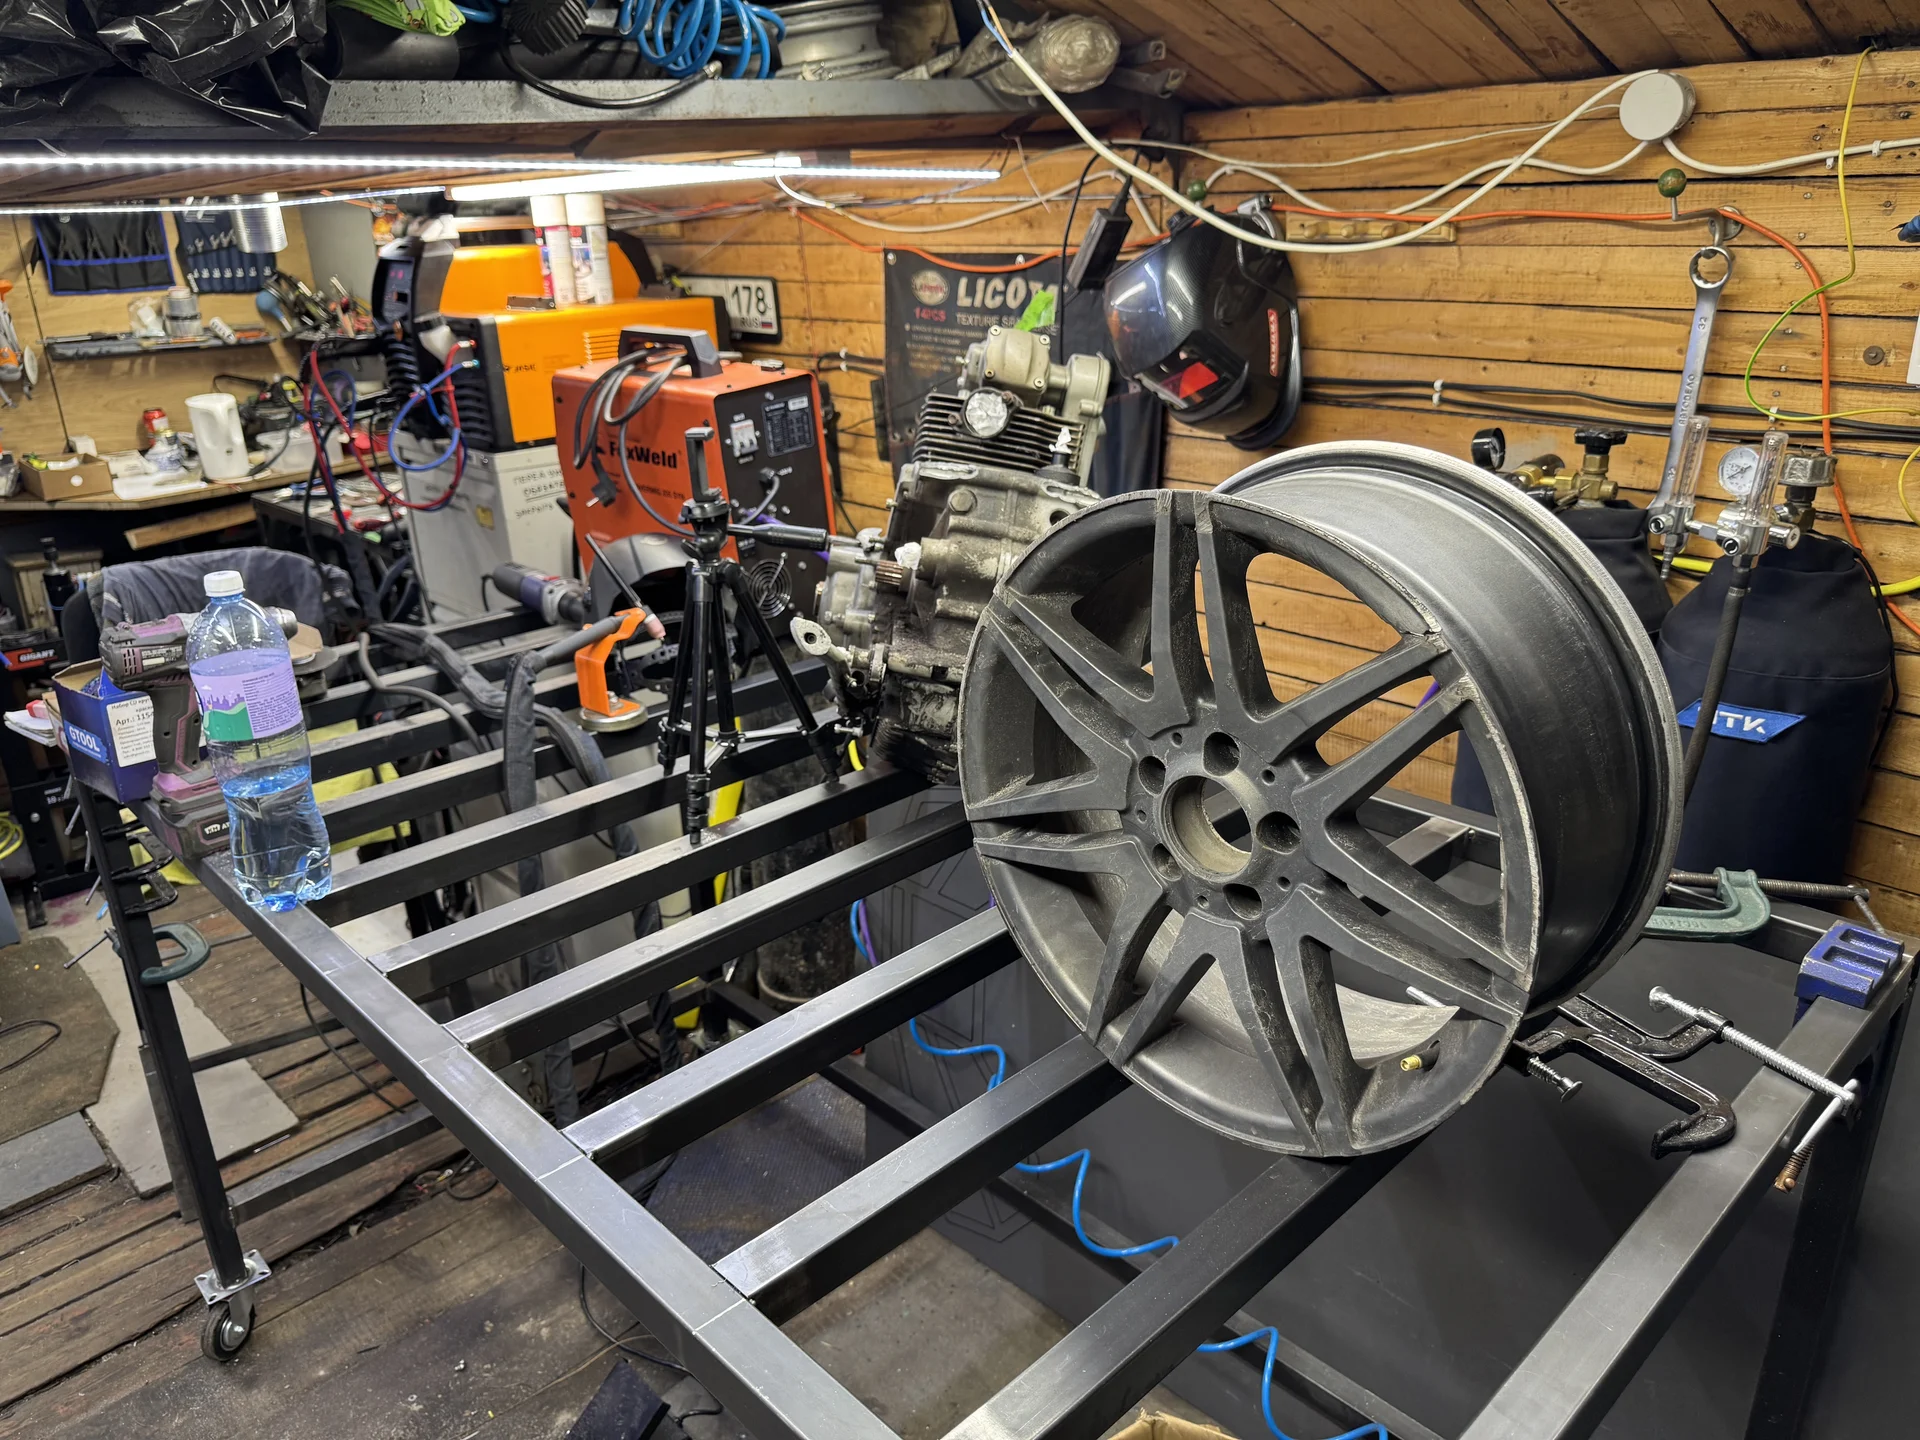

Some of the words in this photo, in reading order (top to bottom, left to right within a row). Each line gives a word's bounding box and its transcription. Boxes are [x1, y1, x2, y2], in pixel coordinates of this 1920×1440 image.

[732, 286, 767, 315] 178
[741, 318, 759, 328] RUS
[1697, 316, 1707, 330] 32
[609, 441, 677, 468] FxWeld
[19, 649, 55, 662] GIGANT
[69, 725, 100, 752] GTOOL
